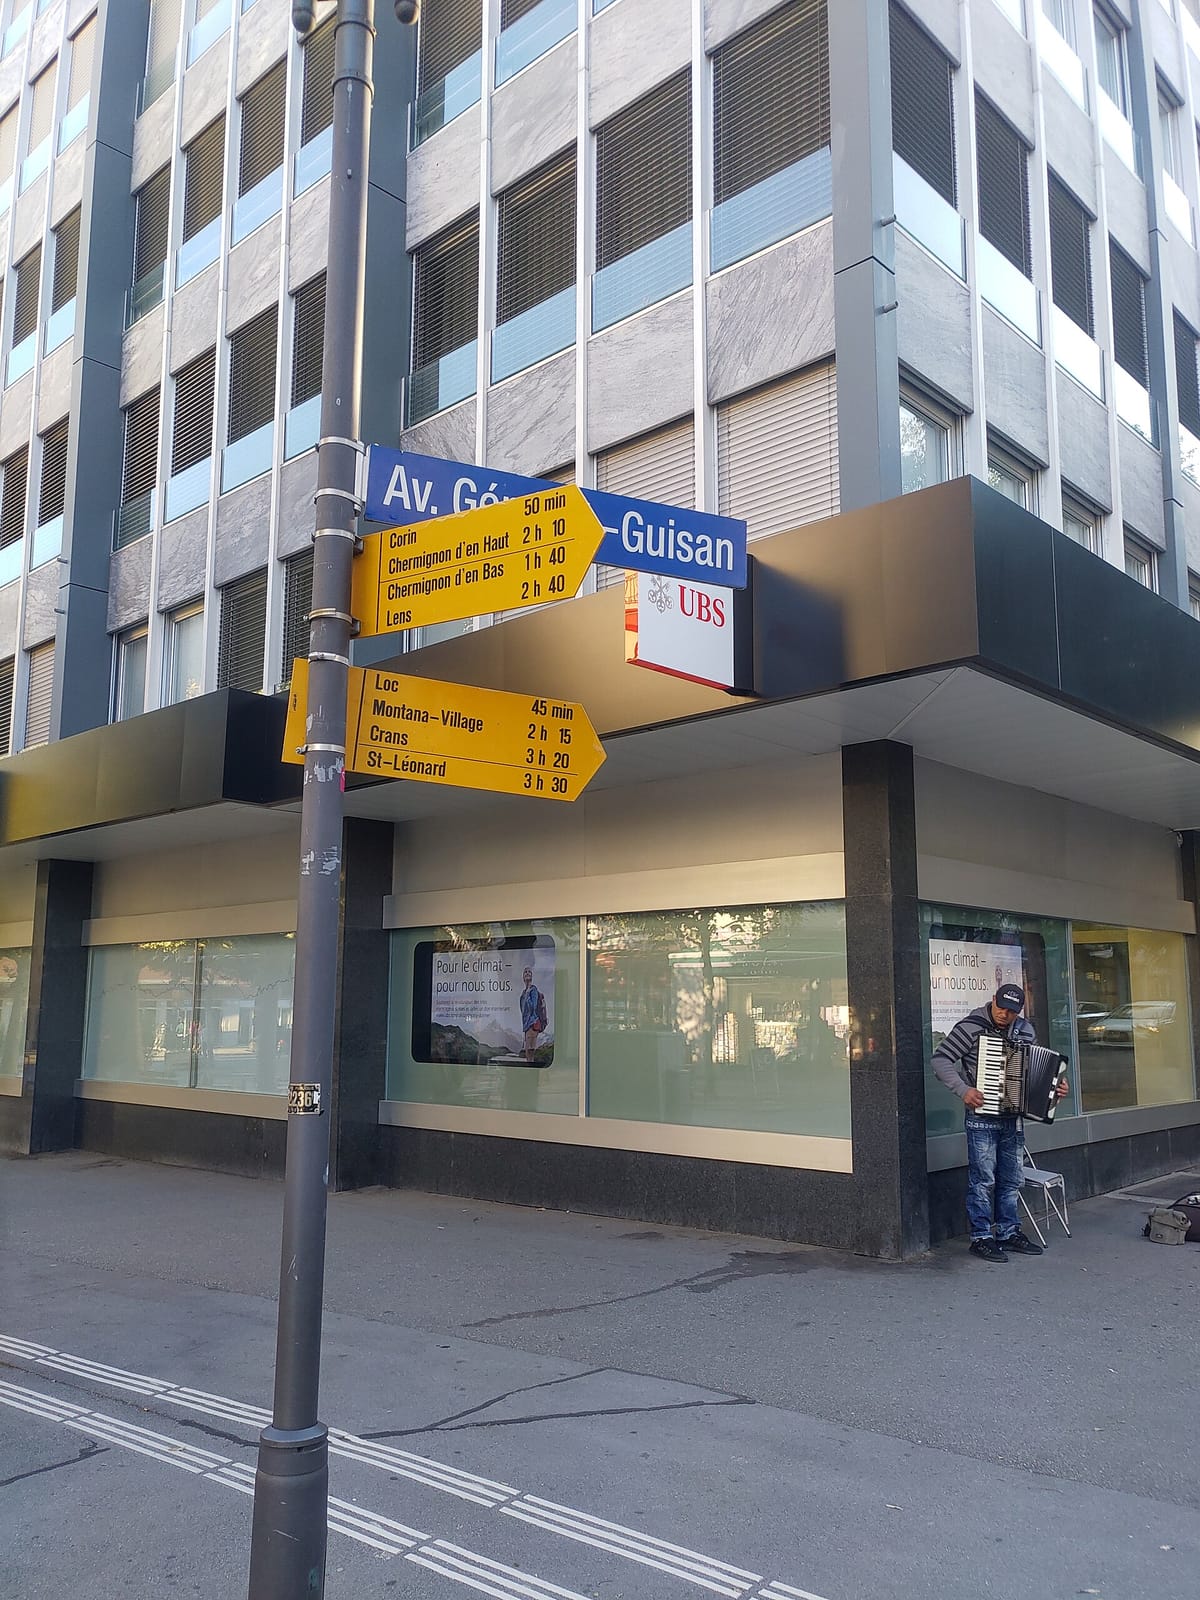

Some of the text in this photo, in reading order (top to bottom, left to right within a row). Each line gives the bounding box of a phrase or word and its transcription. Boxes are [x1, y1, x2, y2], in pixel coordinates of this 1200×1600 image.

[383, 464, 438, 515] Av.
[453, 477, 516, 514] Gé
[389, 492, 566, 549] Corin 50 min
[388, 518, 566, 575] Chermignon d'en Haut 2 h 10
[387, 546, 566, 601] Chermignon d'en Bas 1 h 40
[386, 574, 565, 627] Lens 2 h 40
[678, 584, 726, 628] UBS
[375, 673, 573, 720] Loc 45 min
[372, 699, 572, 744] Montana-Village 2 h 15
[370, 725, 570, 769] Crans 3 h 20
[367, 750, 568, 794] St-Léonard 3 h 30
[436, 959, 458, 974] Pour
[461, 958, 470, 973] le
[472, 956, 503, 972] climat
[943, 948, 951, 966] le
[953, 949, 980, 968] climat
[436, 978, 513, 996] pour nous tous.
[944, 976, 966, 991] nous
[968, 975, 989, 991] tous.
